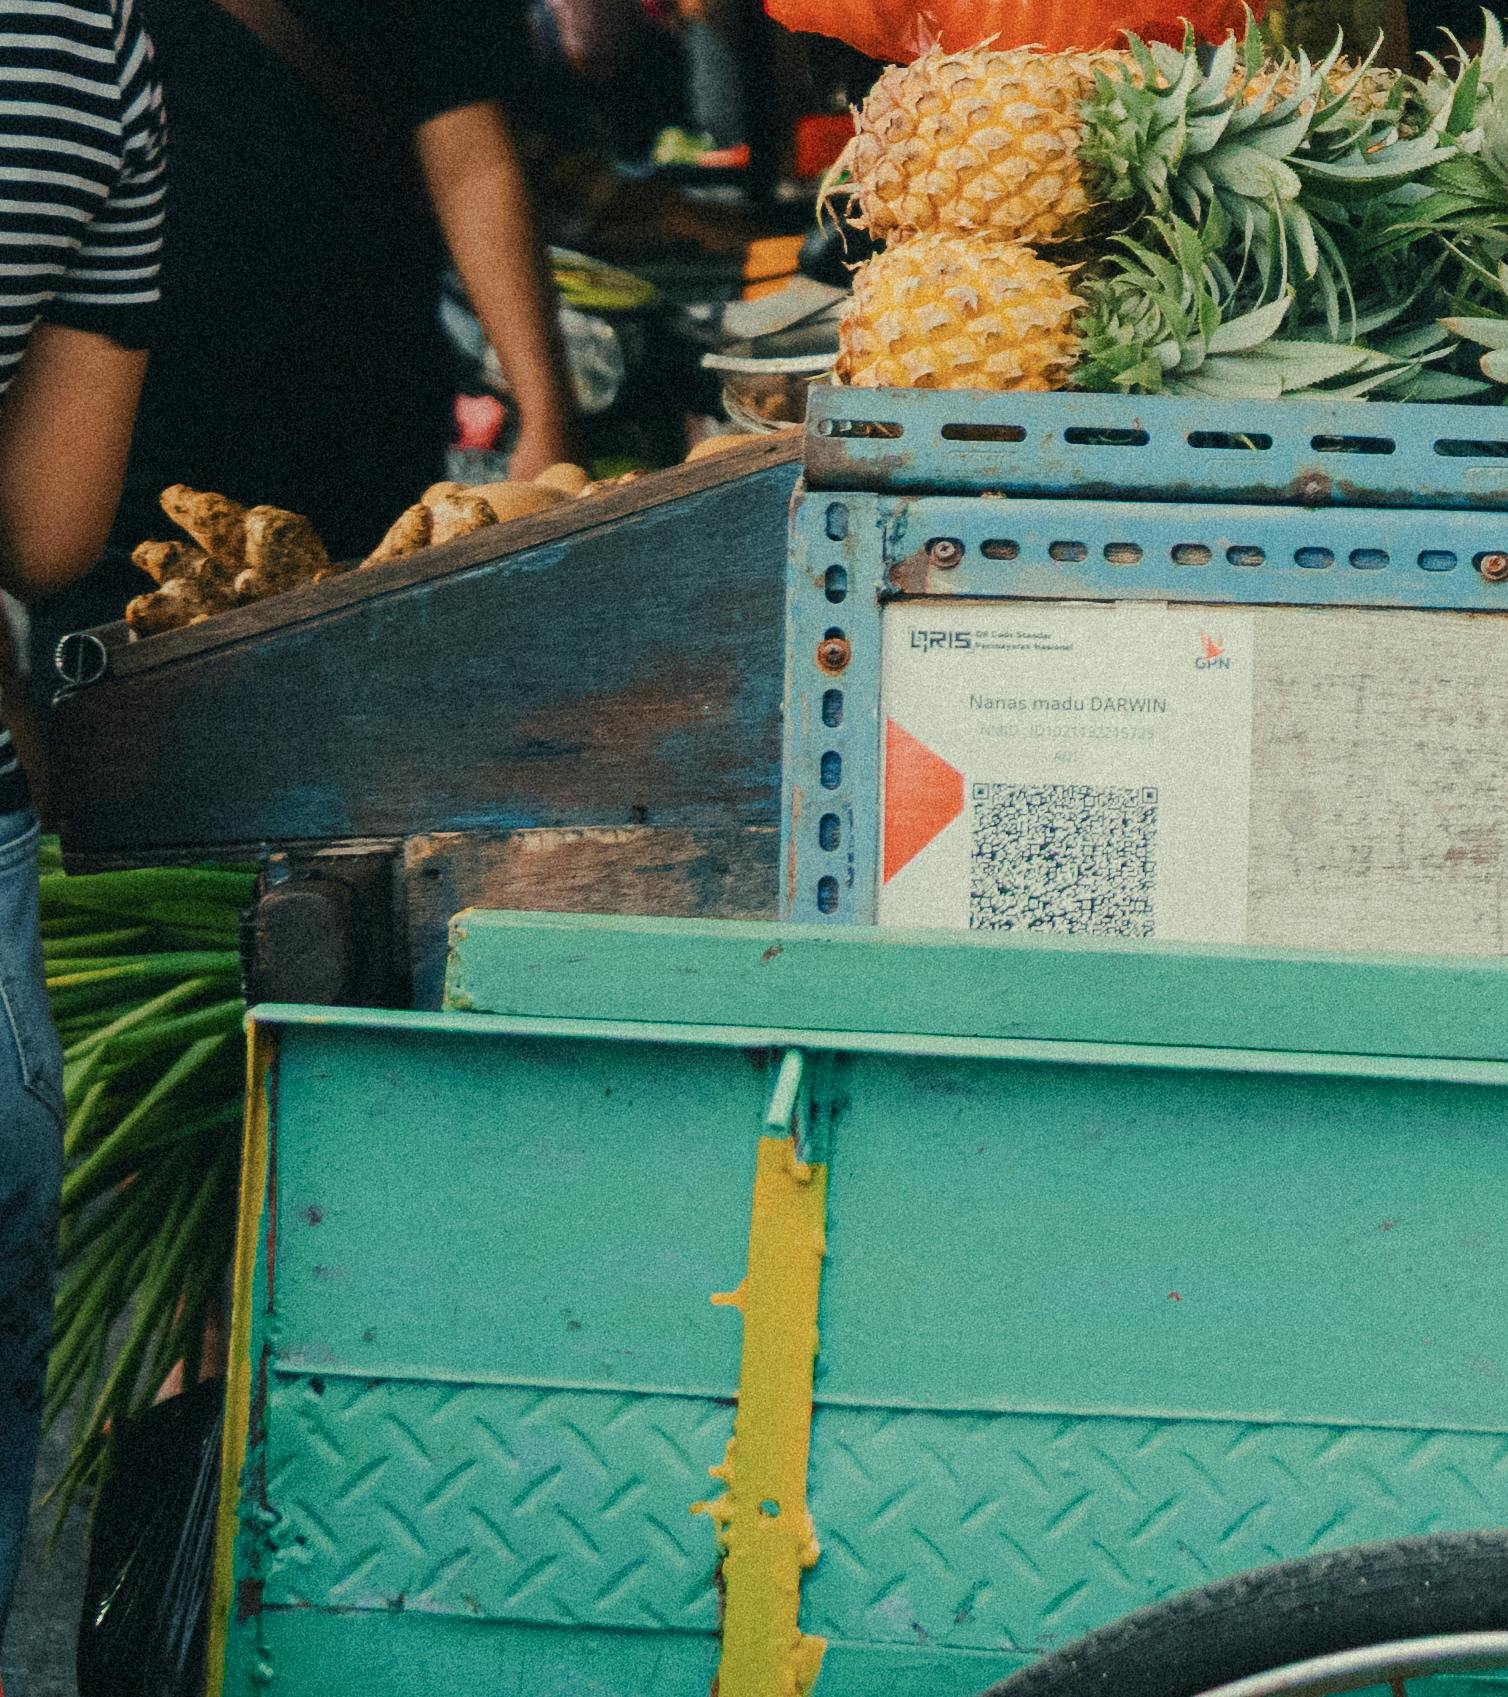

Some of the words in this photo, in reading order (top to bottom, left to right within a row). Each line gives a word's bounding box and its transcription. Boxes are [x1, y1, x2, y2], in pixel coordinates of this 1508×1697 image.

[969, 694, 1027, 710] Nanas
[1032, 696, 1084, 711] madu
[1090, 696, 1167, 713] DARWIN
